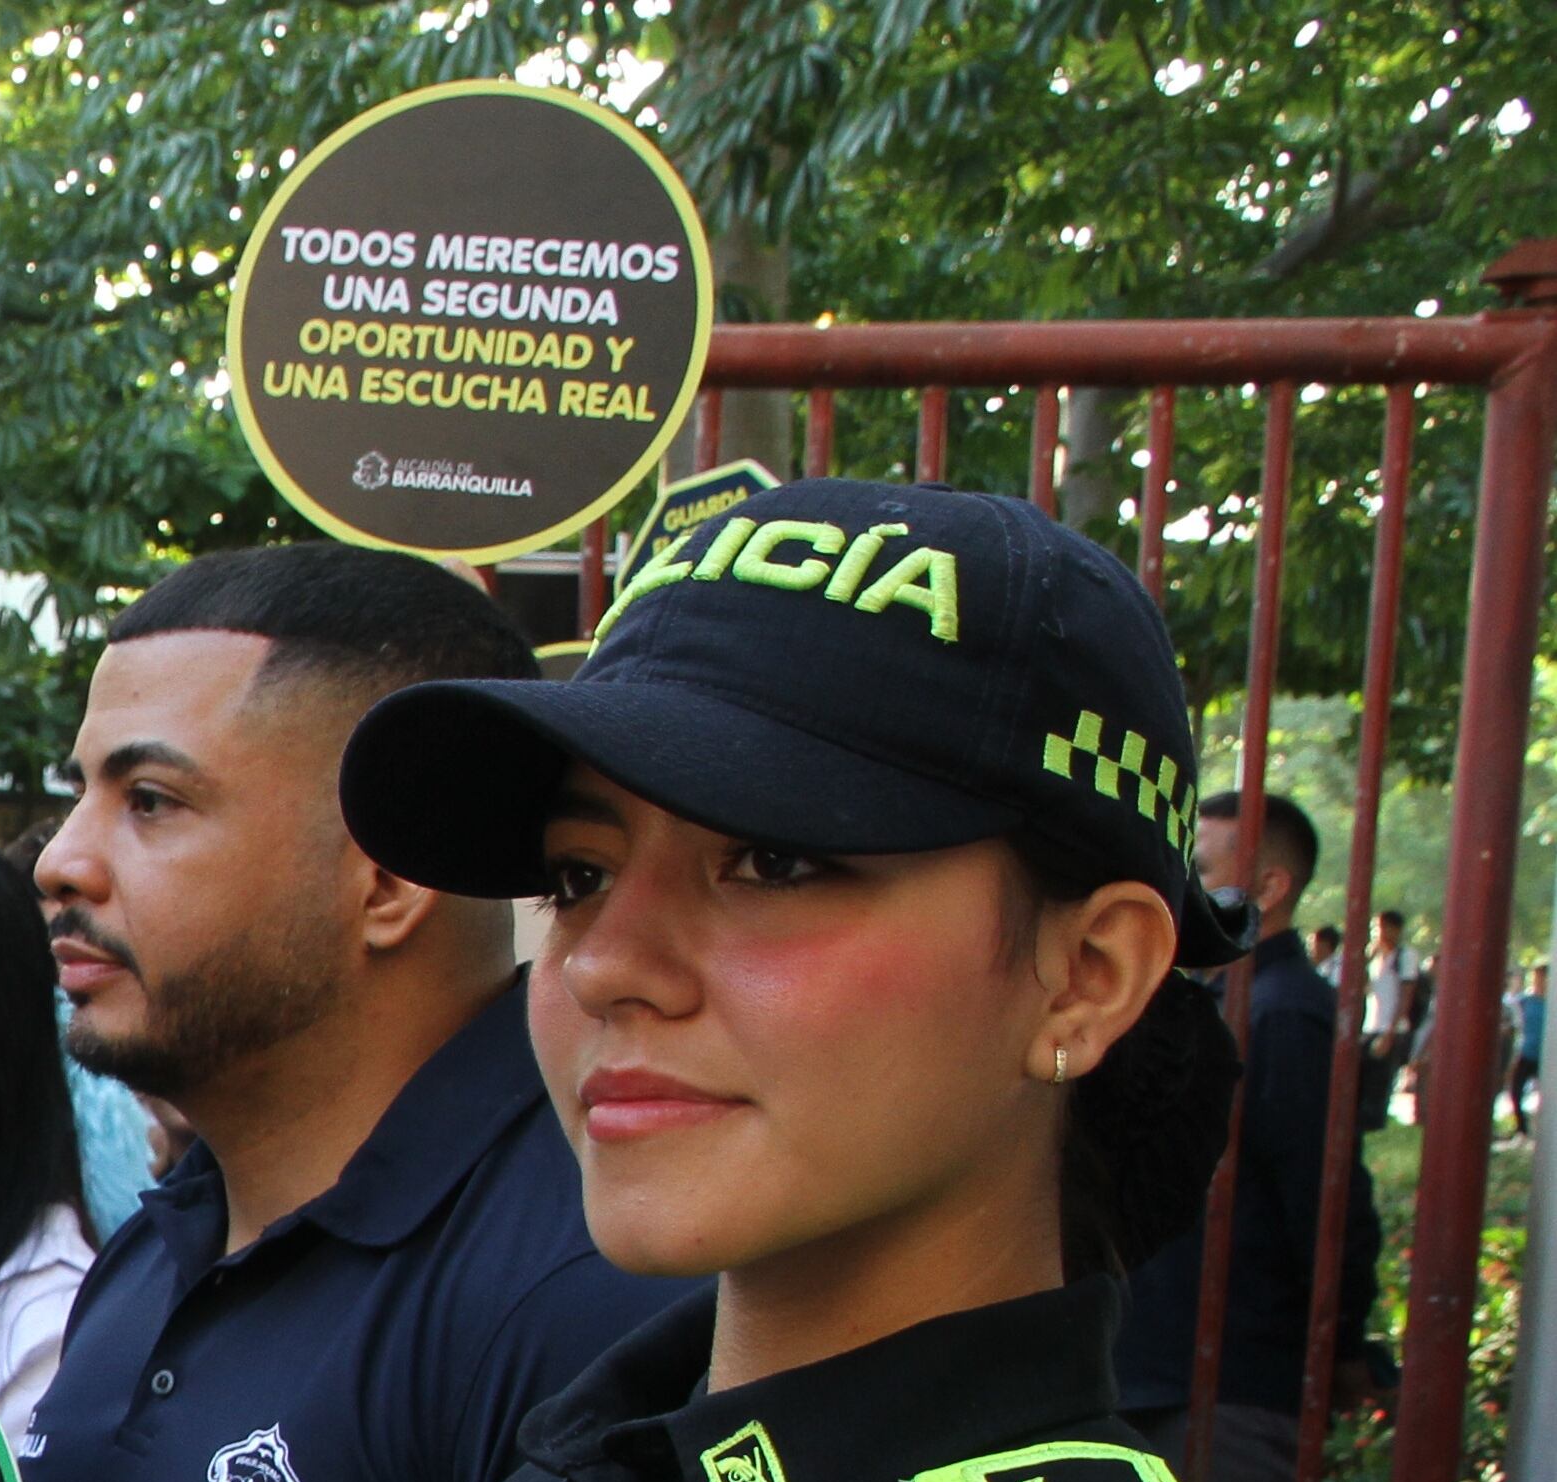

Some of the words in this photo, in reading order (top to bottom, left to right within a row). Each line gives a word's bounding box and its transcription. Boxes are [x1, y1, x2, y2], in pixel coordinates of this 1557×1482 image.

[281, 226, 415, 269] TODOS
[425, 234, 679, 282] MERECEMOS
[323, 276, 409, 313] UNA
[421, 281, 617, 325] SEGUNDA
[299, 319, 593, 370] OPORTUNIDAD
[606, 337, 634, 373] Y
[263, 363, 348, 401] UNA
[360, 368, 547, 415] ESCUCHA
[559, 380, 656, 422] REAL
[391, 470, 533, 497] BARRANQUILLA
[456, 461, 473, 474] DE
[663, 485, 749, 532] GUARDA
[588, 517, 959, 660] LICÍA
